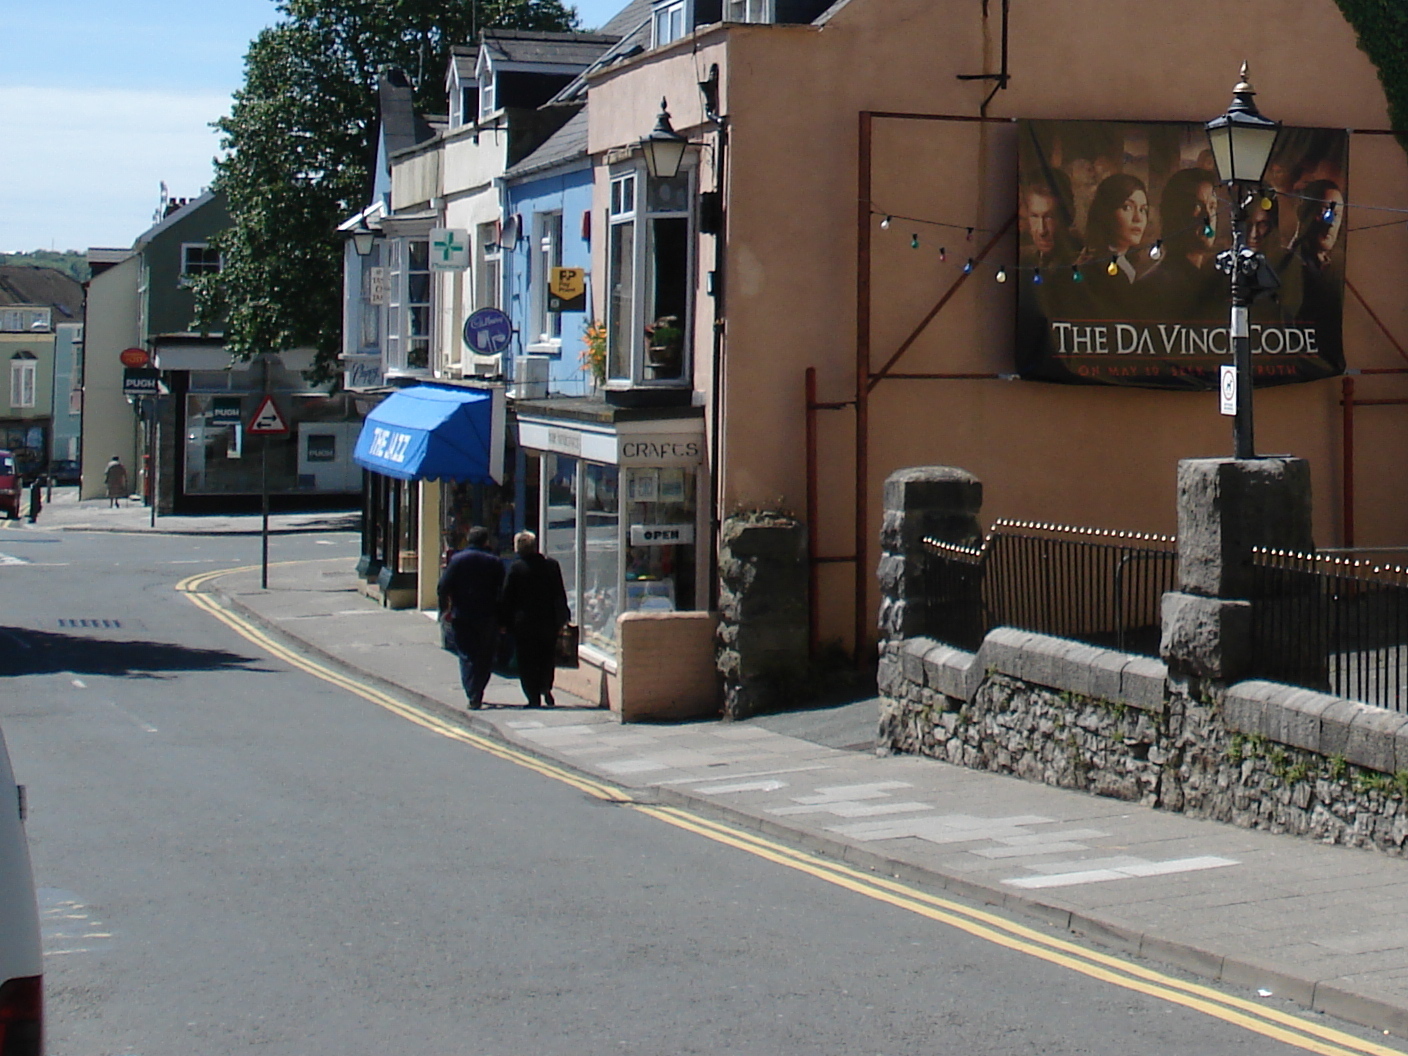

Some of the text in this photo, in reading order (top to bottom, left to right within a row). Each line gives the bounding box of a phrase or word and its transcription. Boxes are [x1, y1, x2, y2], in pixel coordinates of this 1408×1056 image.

[1052, 322, 1109, 354] THE
[1115, 323, 1156, 355] DA
[1250, 324, 1319, 355] CODE
[1256, 366, 1297, 376] RUTH
[126, 379, 156, 388] PUGH
[369, 427, 391, 458] THE
[643, 530, 680, 541] OPEN
